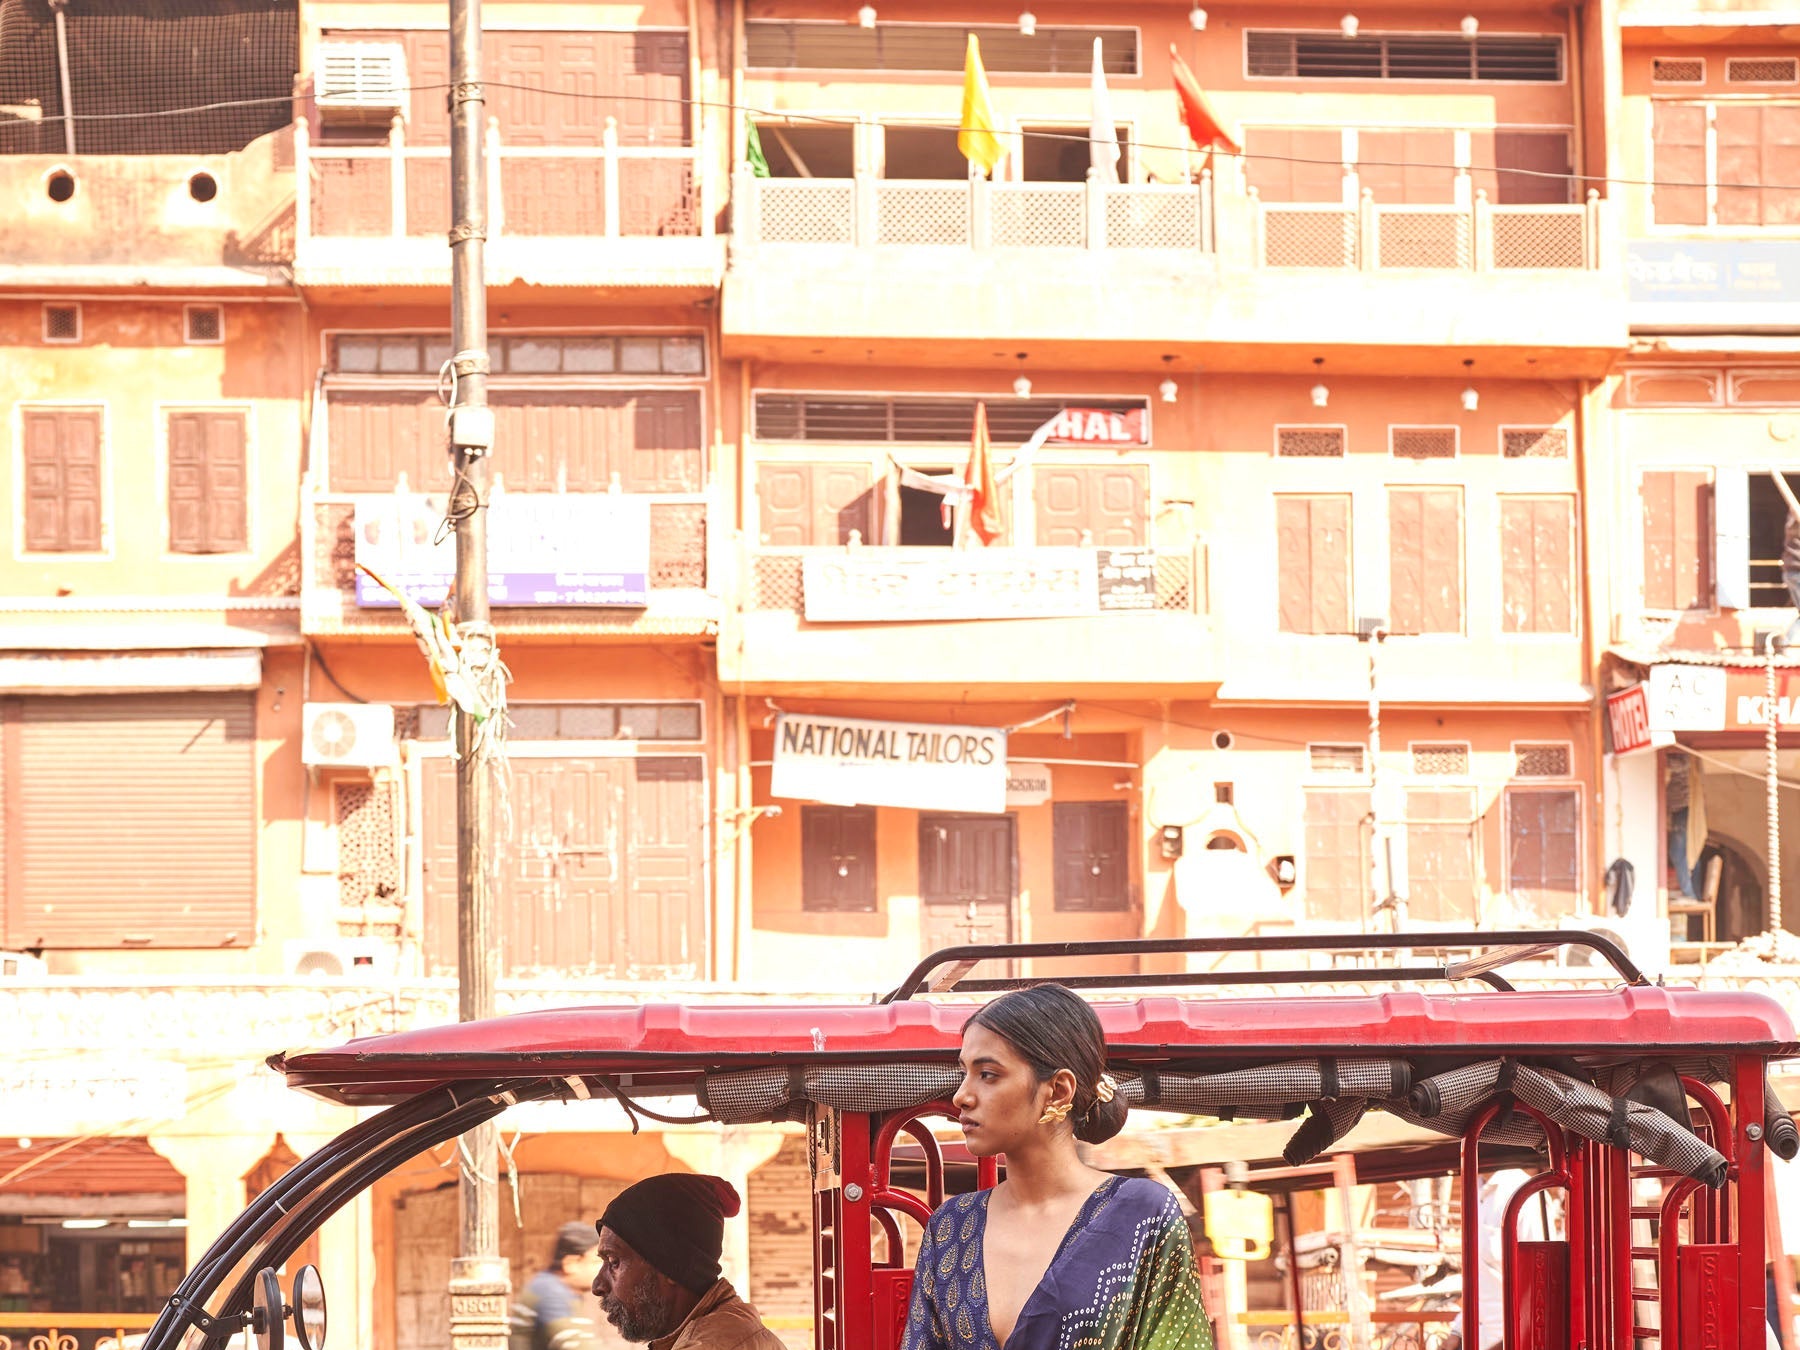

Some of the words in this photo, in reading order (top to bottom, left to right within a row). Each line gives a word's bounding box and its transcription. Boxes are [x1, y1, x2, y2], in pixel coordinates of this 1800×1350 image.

[783, 722, 900, 760] NATIONAL
[907, 731, 994, 765] TAILORS
[1608, 694, 1650, 751] HOTEL
